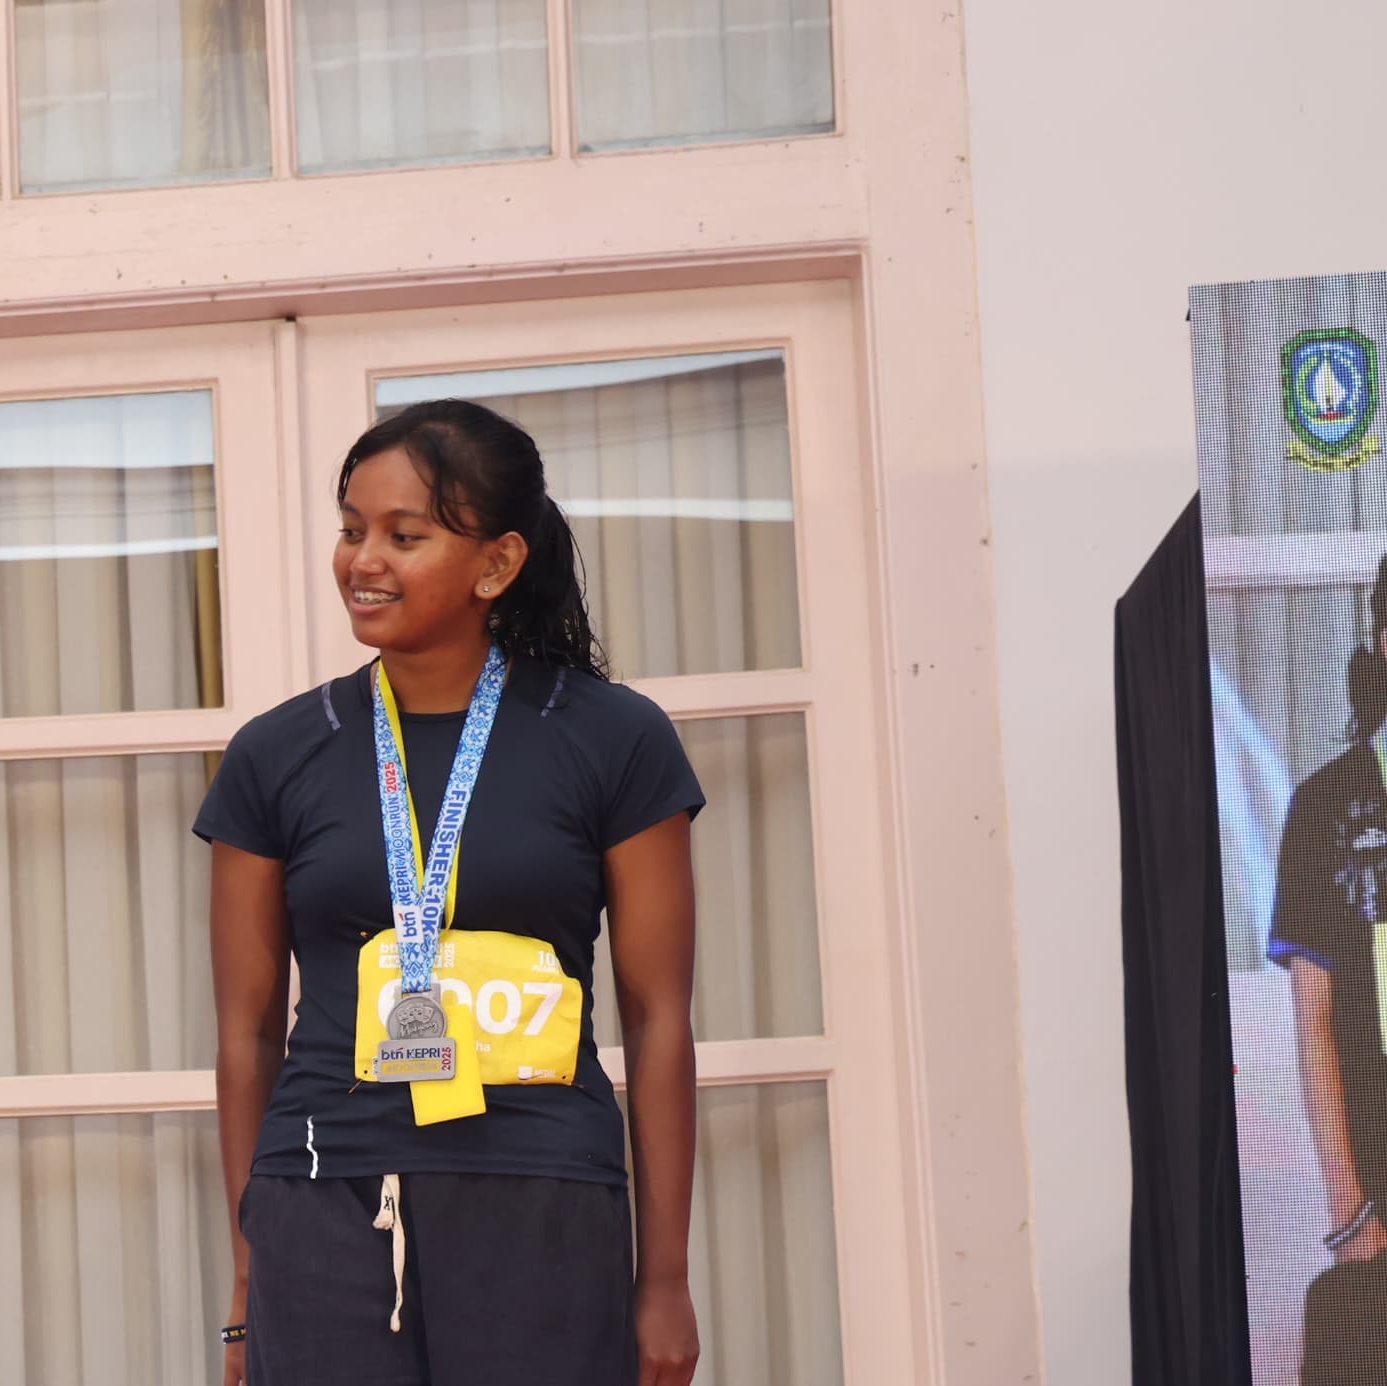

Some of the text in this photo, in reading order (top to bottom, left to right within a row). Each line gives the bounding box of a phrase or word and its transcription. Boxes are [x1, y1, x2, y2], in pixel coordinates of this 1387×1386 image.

[384, 761, 397, 793] 2025
[430, 788, 468, 888] FINISHER
[395, 866, 411, 905] KEPRI
[398, 911, 418, 937] btn
[381, 1047, 440, 1060] btn KEPRI
[441, 1046, 452, 1072] 2025
